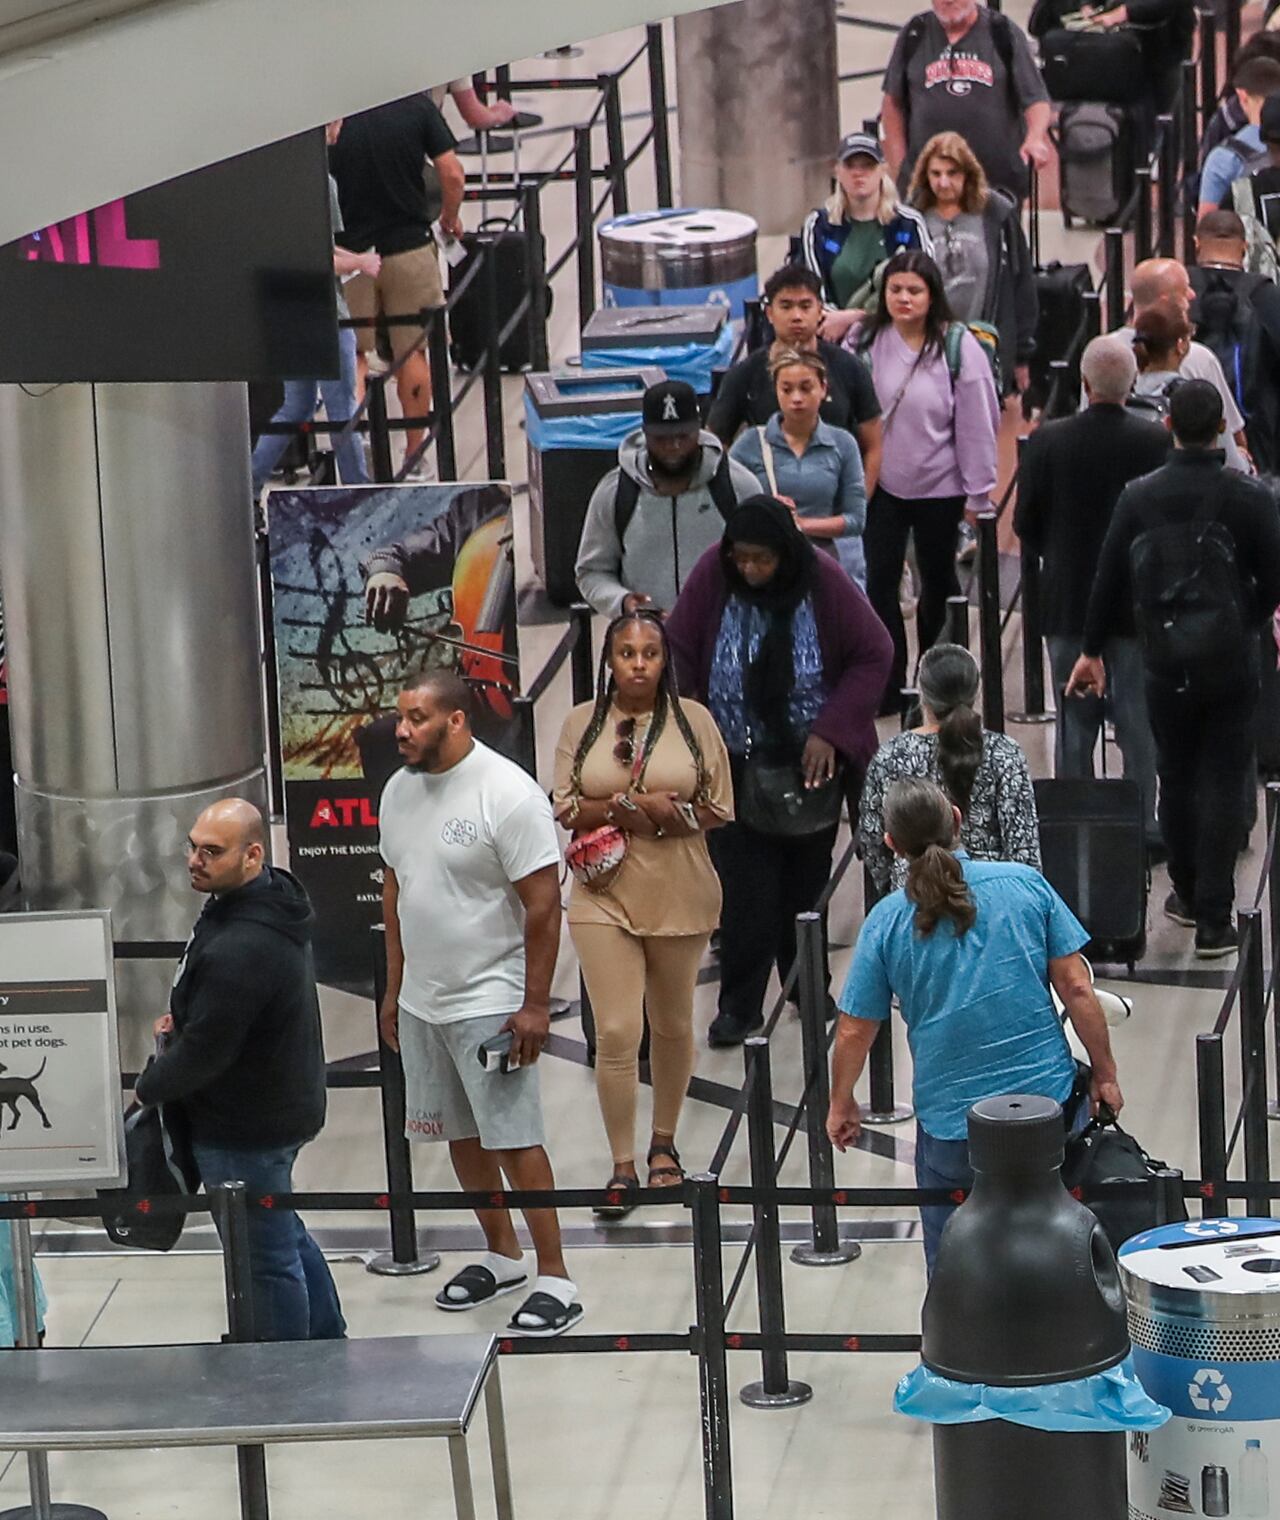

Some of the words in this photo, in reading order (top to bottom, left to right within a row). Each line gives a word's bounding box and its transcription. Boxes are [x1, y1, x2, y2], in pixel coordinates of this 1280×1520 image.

[298, 847, 328, 858] ENJOY
[330, 845, 348, 855] THE
[13, 1024, 25, 1033] in
[28, 1025, 52, 1033] use.
[12, 1038, 32, 1048] pet
[35, 1038, 68, 1048] dogs.
